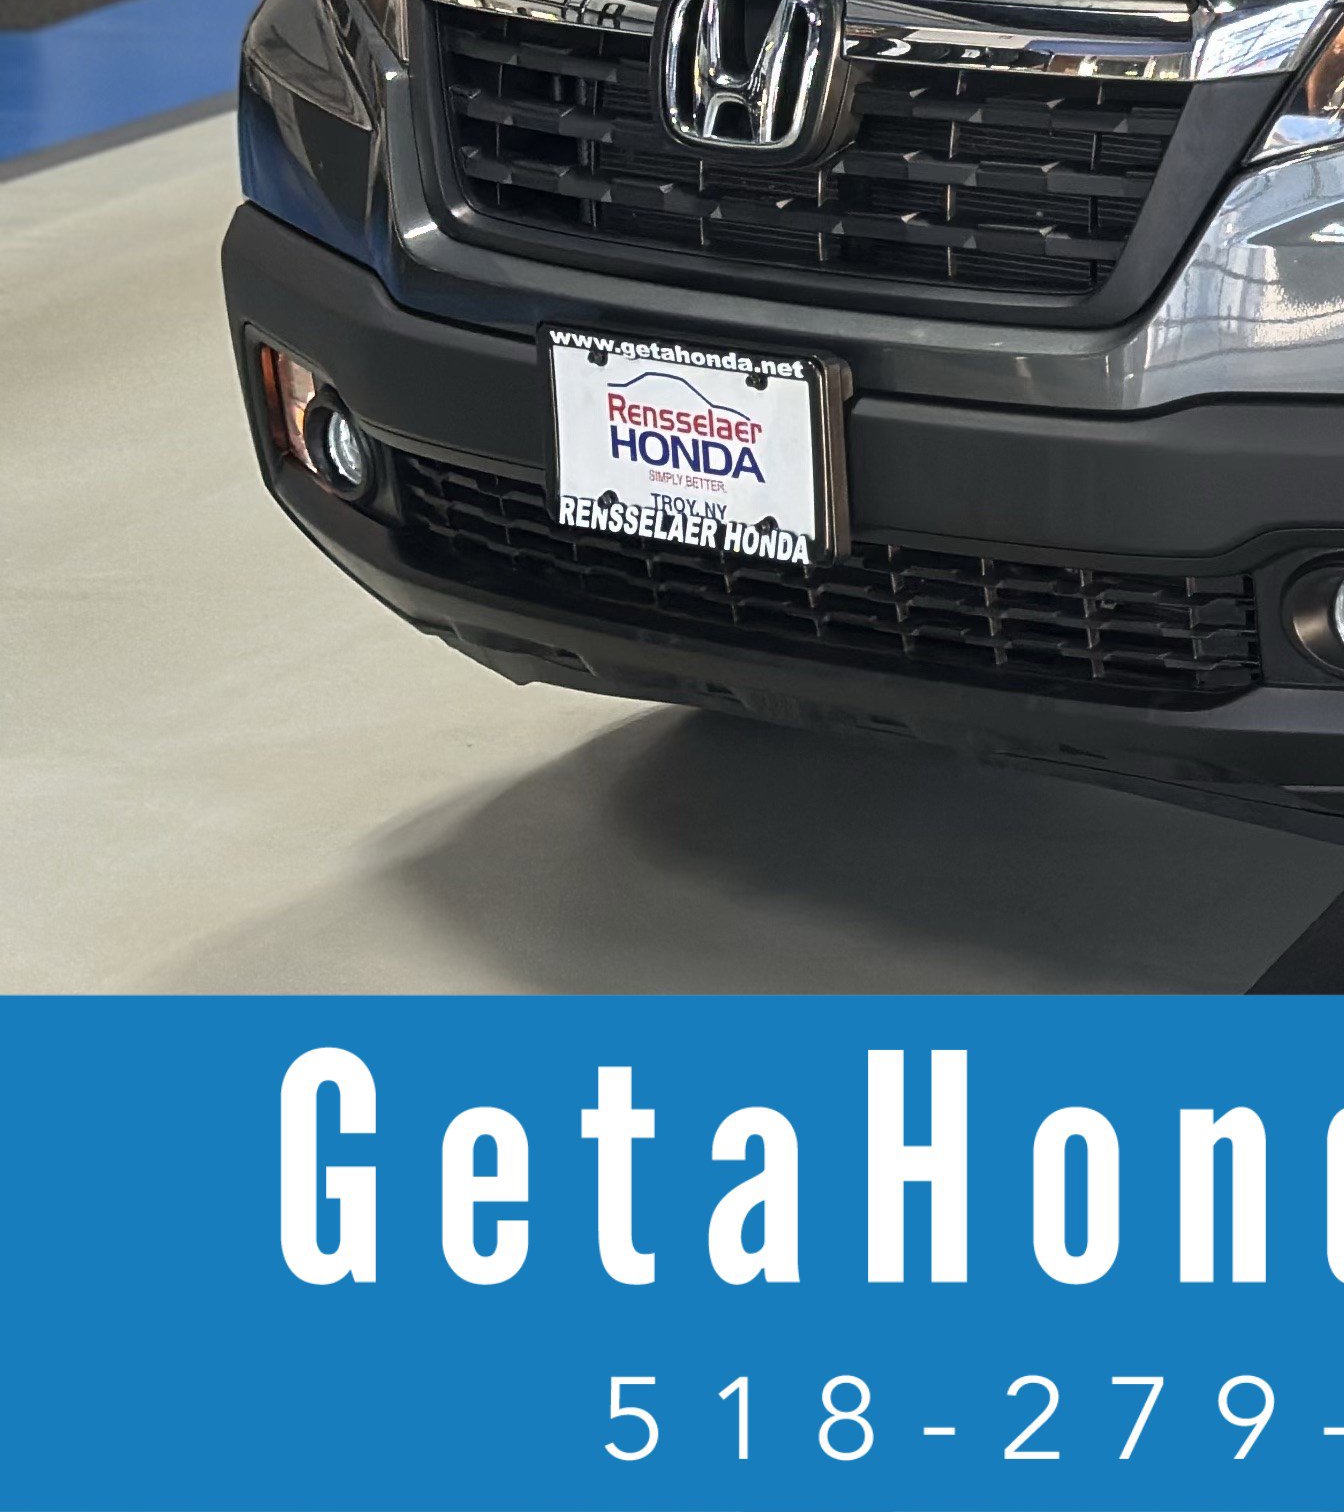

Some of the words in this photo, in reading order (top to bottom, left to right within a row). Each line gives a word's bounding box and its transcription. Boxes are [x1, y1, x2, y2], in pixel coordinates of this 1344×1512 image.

[549, 329, 806, 378] www.getahonda.net
[607, 392, 763, 444] Rensselaer
[609, 425, 766, 483] HONDA
[648, 469, 683, 486] SIMPLY
[559, 495, 717, 549] RENSSELAER
[724, 520, 810, 565] HONDA
[705, 501, 727, 520] NY
